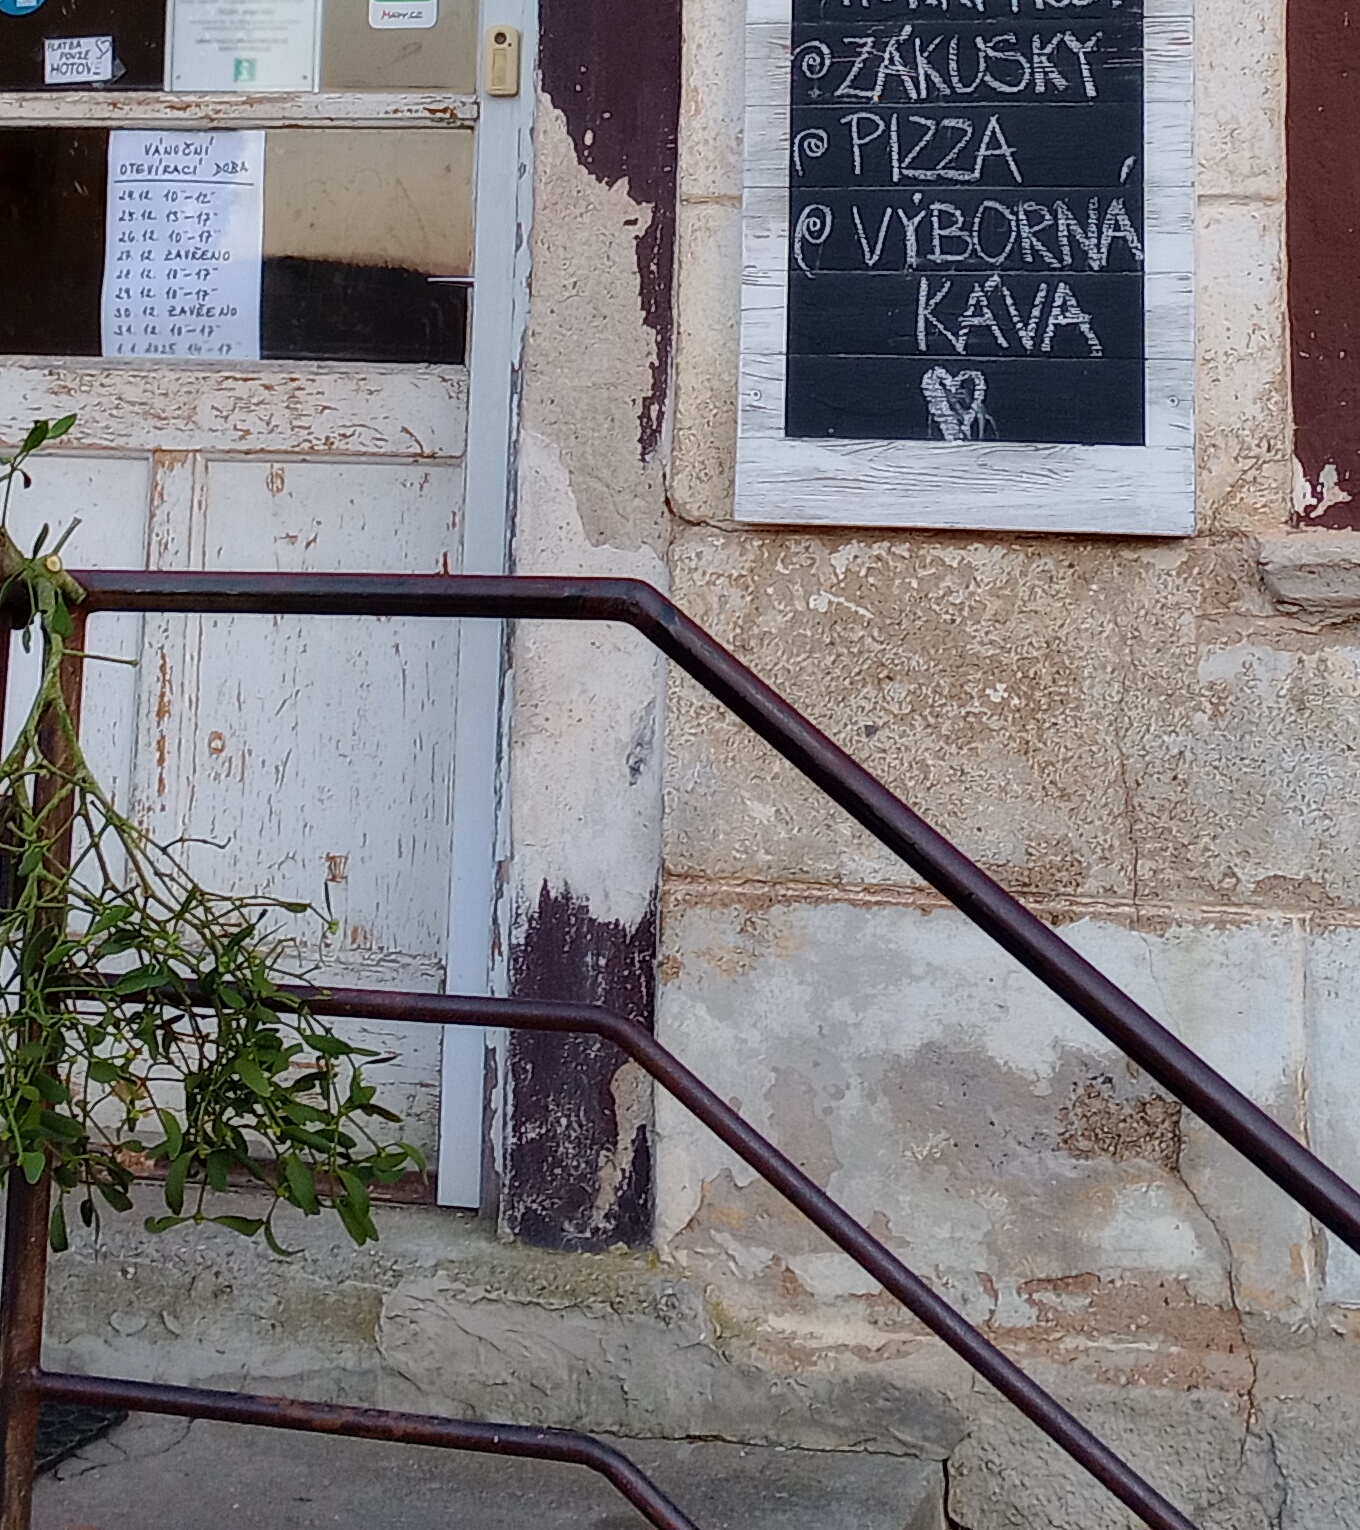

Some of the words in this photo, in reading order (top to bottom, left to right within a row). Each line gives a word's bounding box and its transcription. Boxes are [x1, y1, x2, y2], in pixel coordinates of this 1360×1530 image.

[834, 25, 1105, 103] ZÁKUSKY
[119, 158, 203, 176] OTEVÍRACÍ
[212, 160, 249, 177] DOBA
[144, 135, 215, 157] VÁNOČNÍ
[840, 112, 1023, 184] PIZZA
[852, 155, 1144, 271] VÝBORNÁ
[164, 246, 231, 261] ZAVŘENO
[168, 302, 237, 318] ZAVŘENO
[917, 274, 1103, 357] KÁVA
